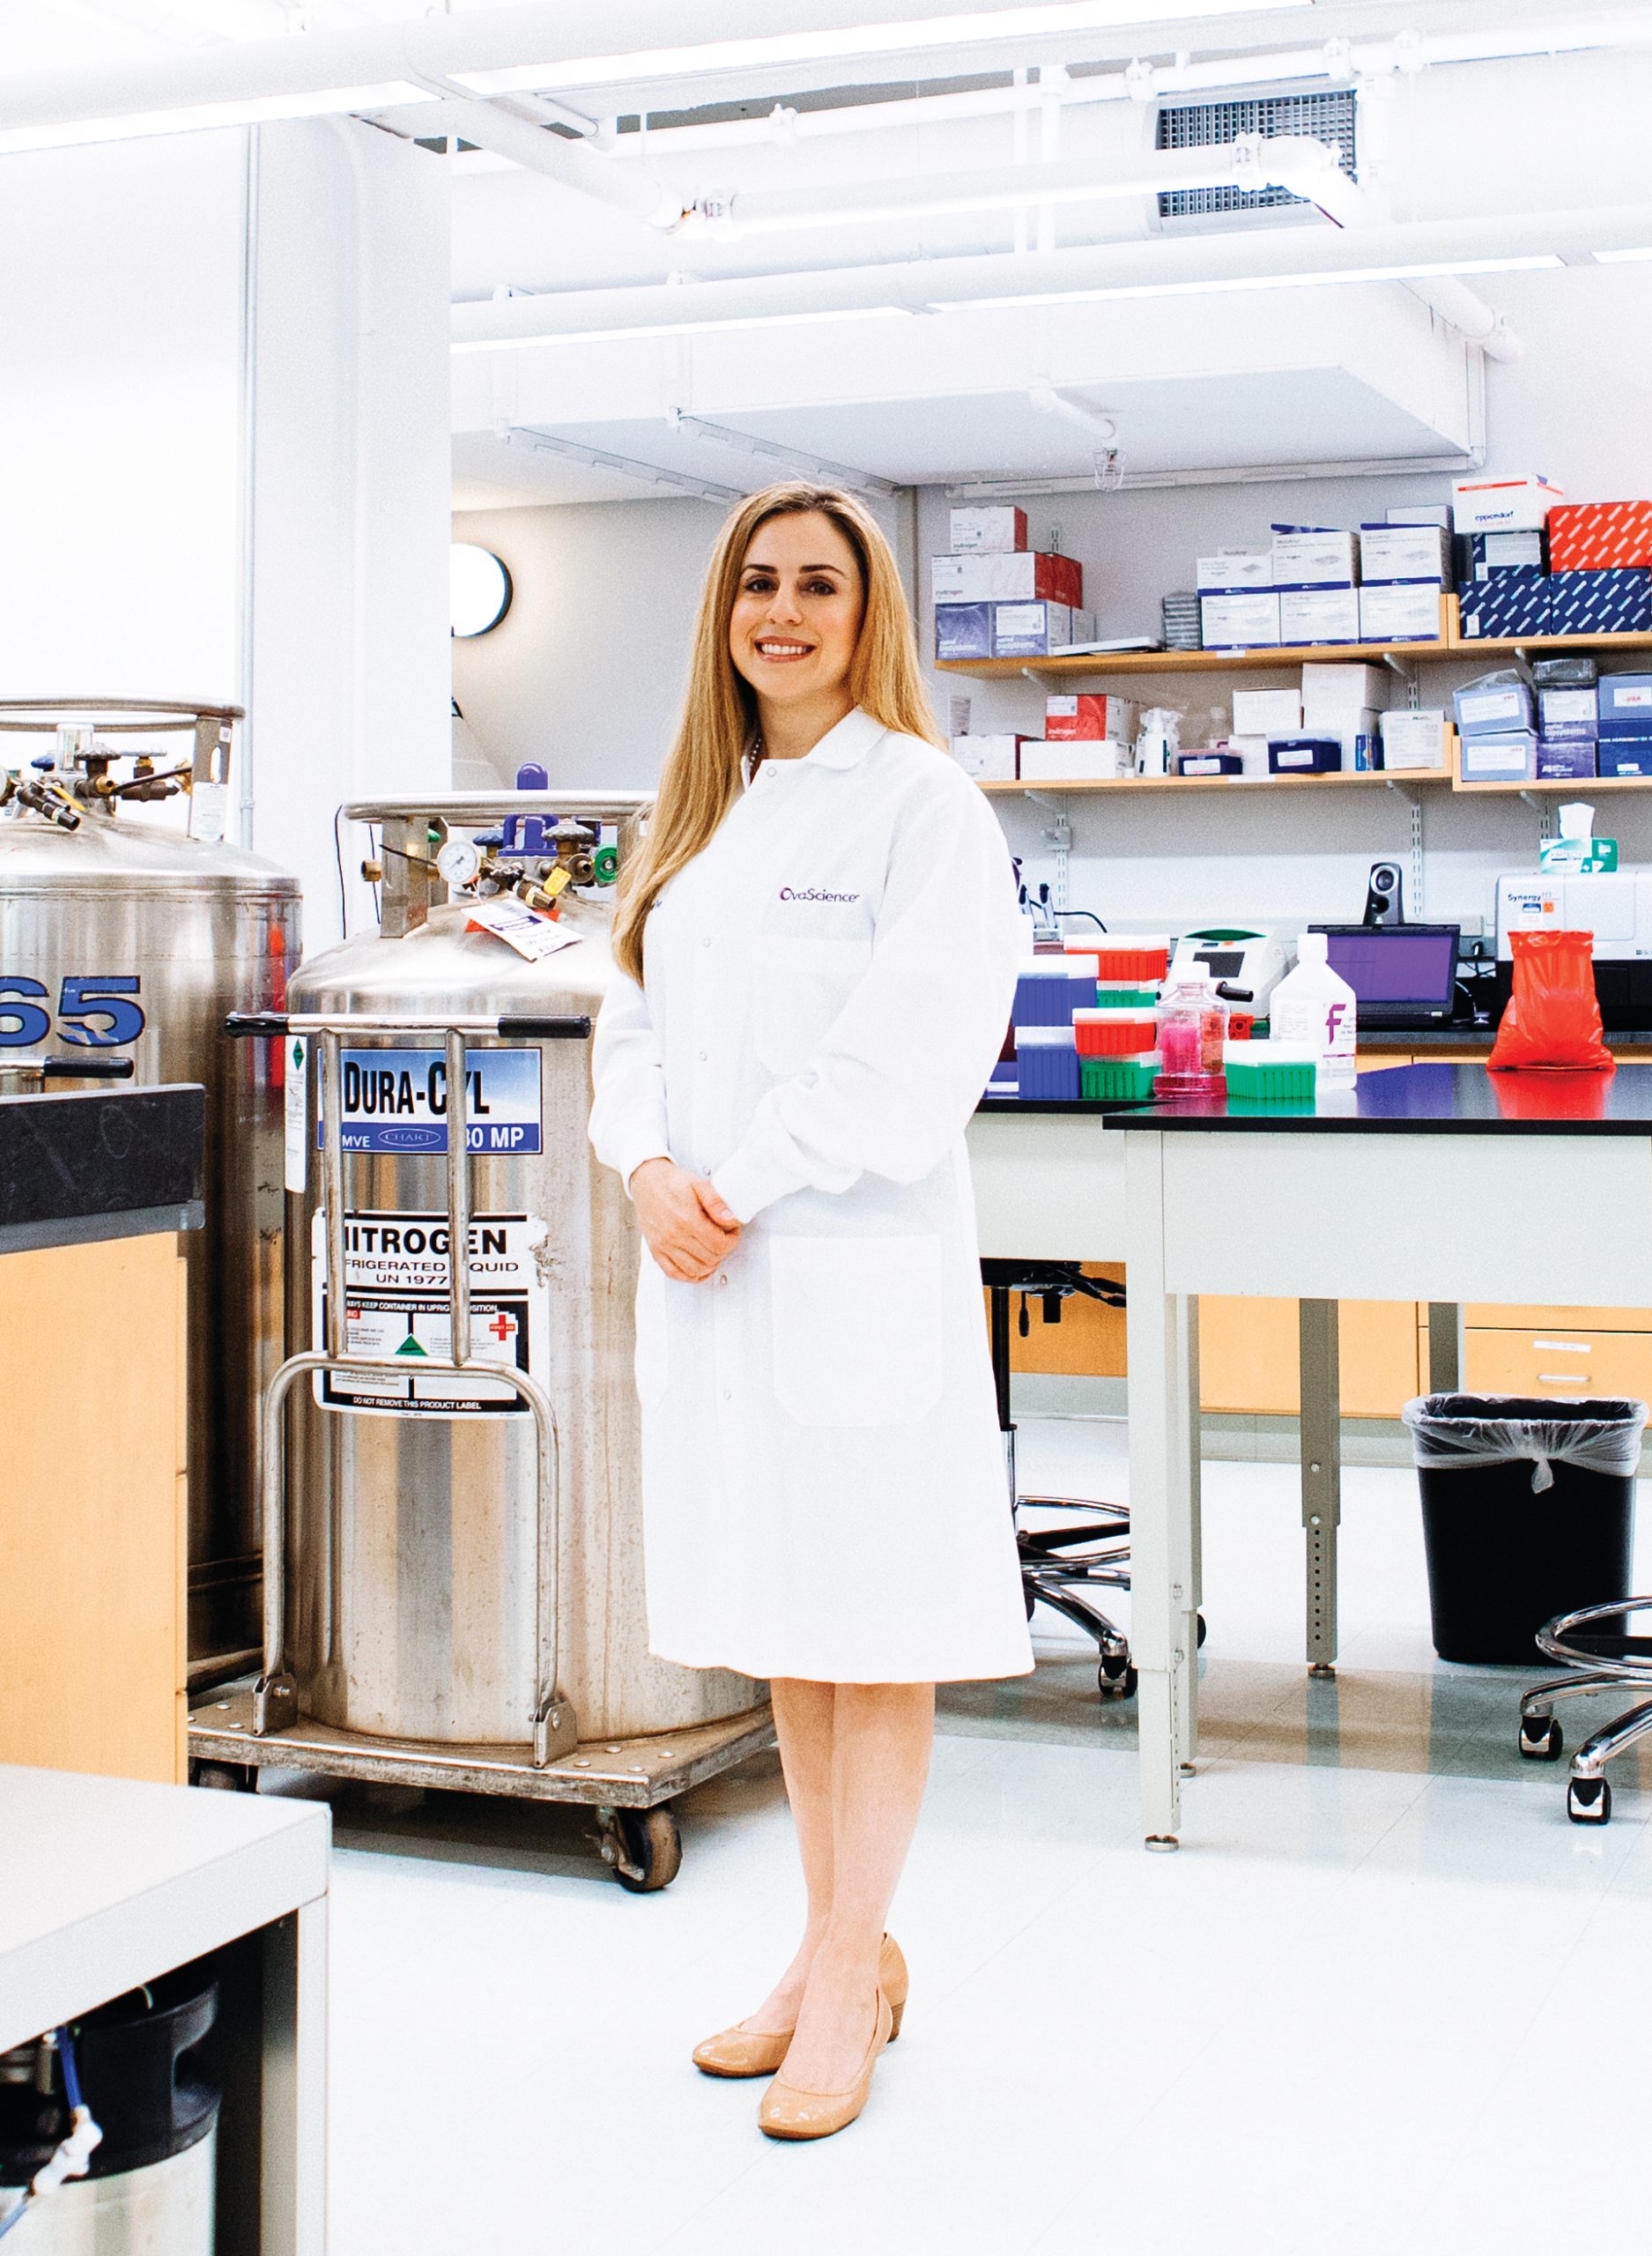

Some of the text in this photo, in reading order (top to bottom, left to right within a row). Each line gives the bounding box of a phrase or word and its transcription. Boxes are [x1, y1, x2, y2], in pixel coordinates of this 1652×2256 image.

[780, 887, 859, 902] OvaScience
[344, 1061, 490, 1115] DURA-CL
[342, 1135, 371, 1148] MVE
[491, 1126, 524, 1149] MP
[344, 1226, 507, 1255] ITROGEN
[375, 1273, 448, 1285] UN 1977
[379, 1302, 418, 1311] CONTAINER
[426, 1303, 450, 1312] UPRIG
[362, 1397, 375, 1406] NOT
[375, 1398, 404, 1407] REMOVE
[403, 1399, 419, 1408] THIS
[419, 1399, 455, 1410] PRODUCT
